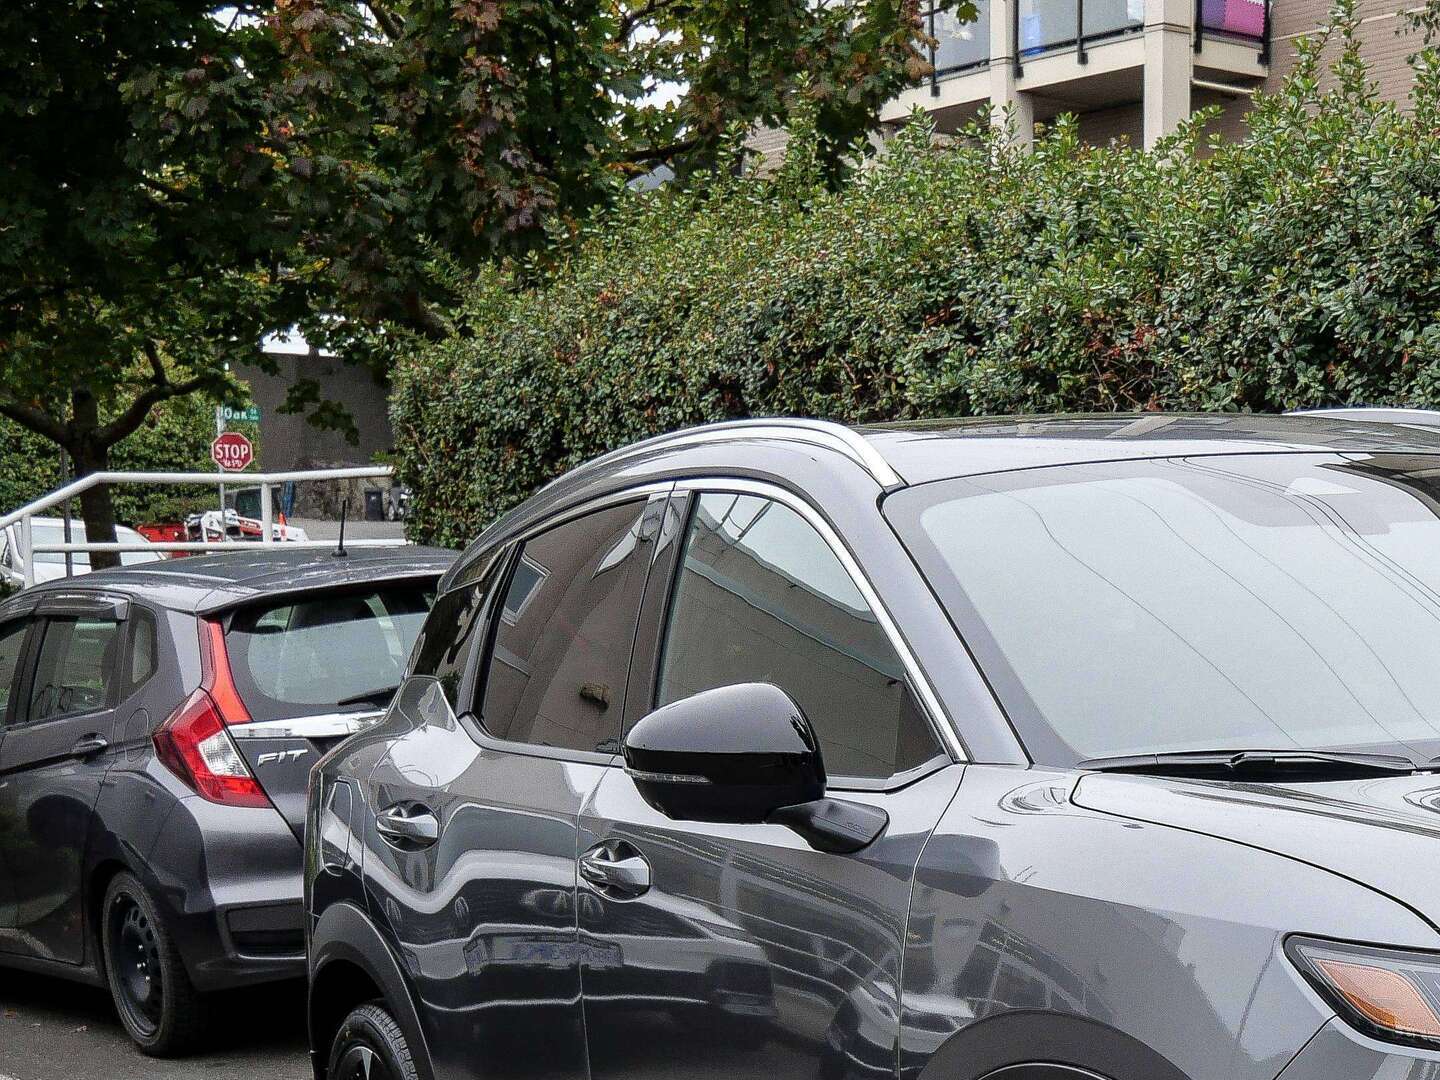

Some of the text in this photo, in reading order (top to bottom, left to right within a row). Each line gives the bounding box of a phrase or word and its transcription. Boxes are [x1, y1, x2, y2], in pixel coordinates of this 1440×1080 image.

[224, 407, 248, 420] Oak
[215, 443, 249, 459] STOP
[257, 749, 308, 767] FIT
